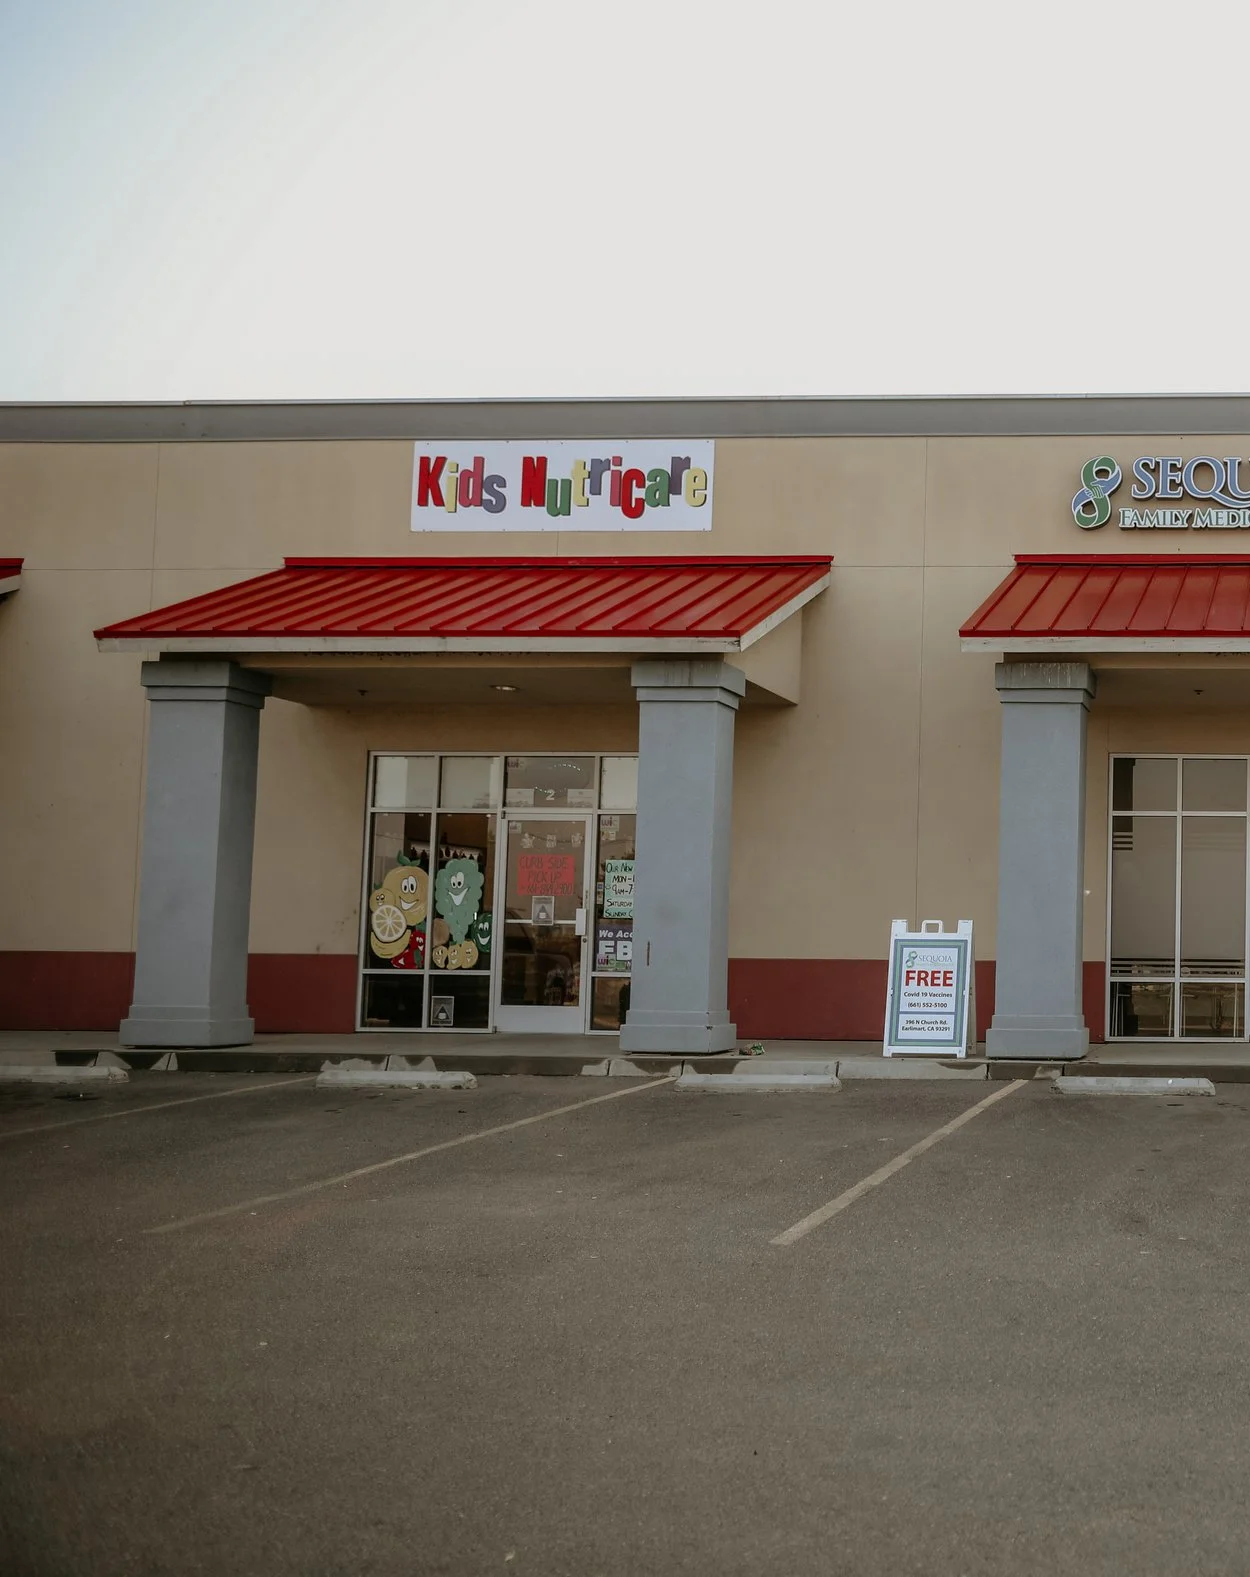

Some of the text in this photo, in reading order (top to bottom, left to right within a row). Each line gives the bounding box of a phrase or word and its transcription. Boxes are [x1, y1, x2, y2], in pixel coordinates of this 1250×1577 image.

[417, 456, 708, 519] Kids Nutricare
[1118, 508, 1192, 530] FAMILY
[545, 789, 556, 801] 2
[520, 856, 543, 869] CURB
[599, 930, 614, 938] We
[905, 970, 954, 987] FREE
